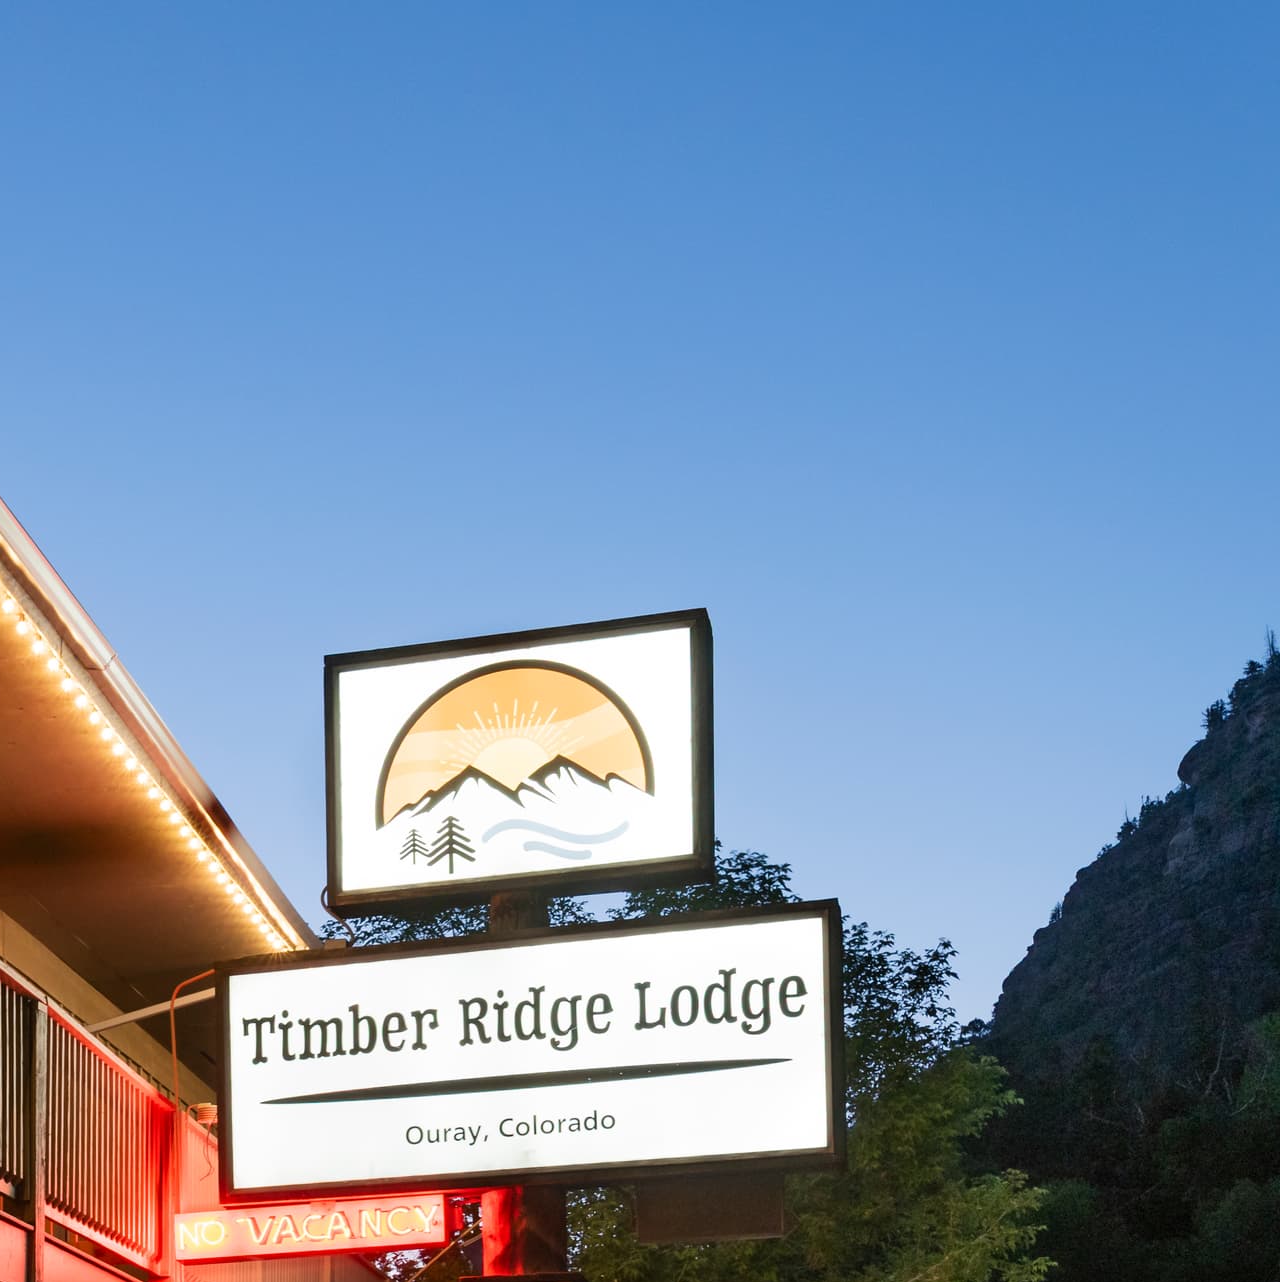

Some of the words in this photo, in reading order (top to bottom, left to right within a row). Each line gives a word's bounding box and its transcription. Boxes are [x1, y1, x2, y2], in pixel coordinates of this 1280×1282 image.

[242, 1002, 438, 1066] Timber
[459, 987, 614, 1051] Ridge
[634, 967, 808, 1036] Lodge
[405, 1120, 491, 1147] Ouray,
[498, 1109, 617, 1139] Colorado
[178, 1219, 226, 1251] NO
[237, 1203, 440, 1245] VACANCY
